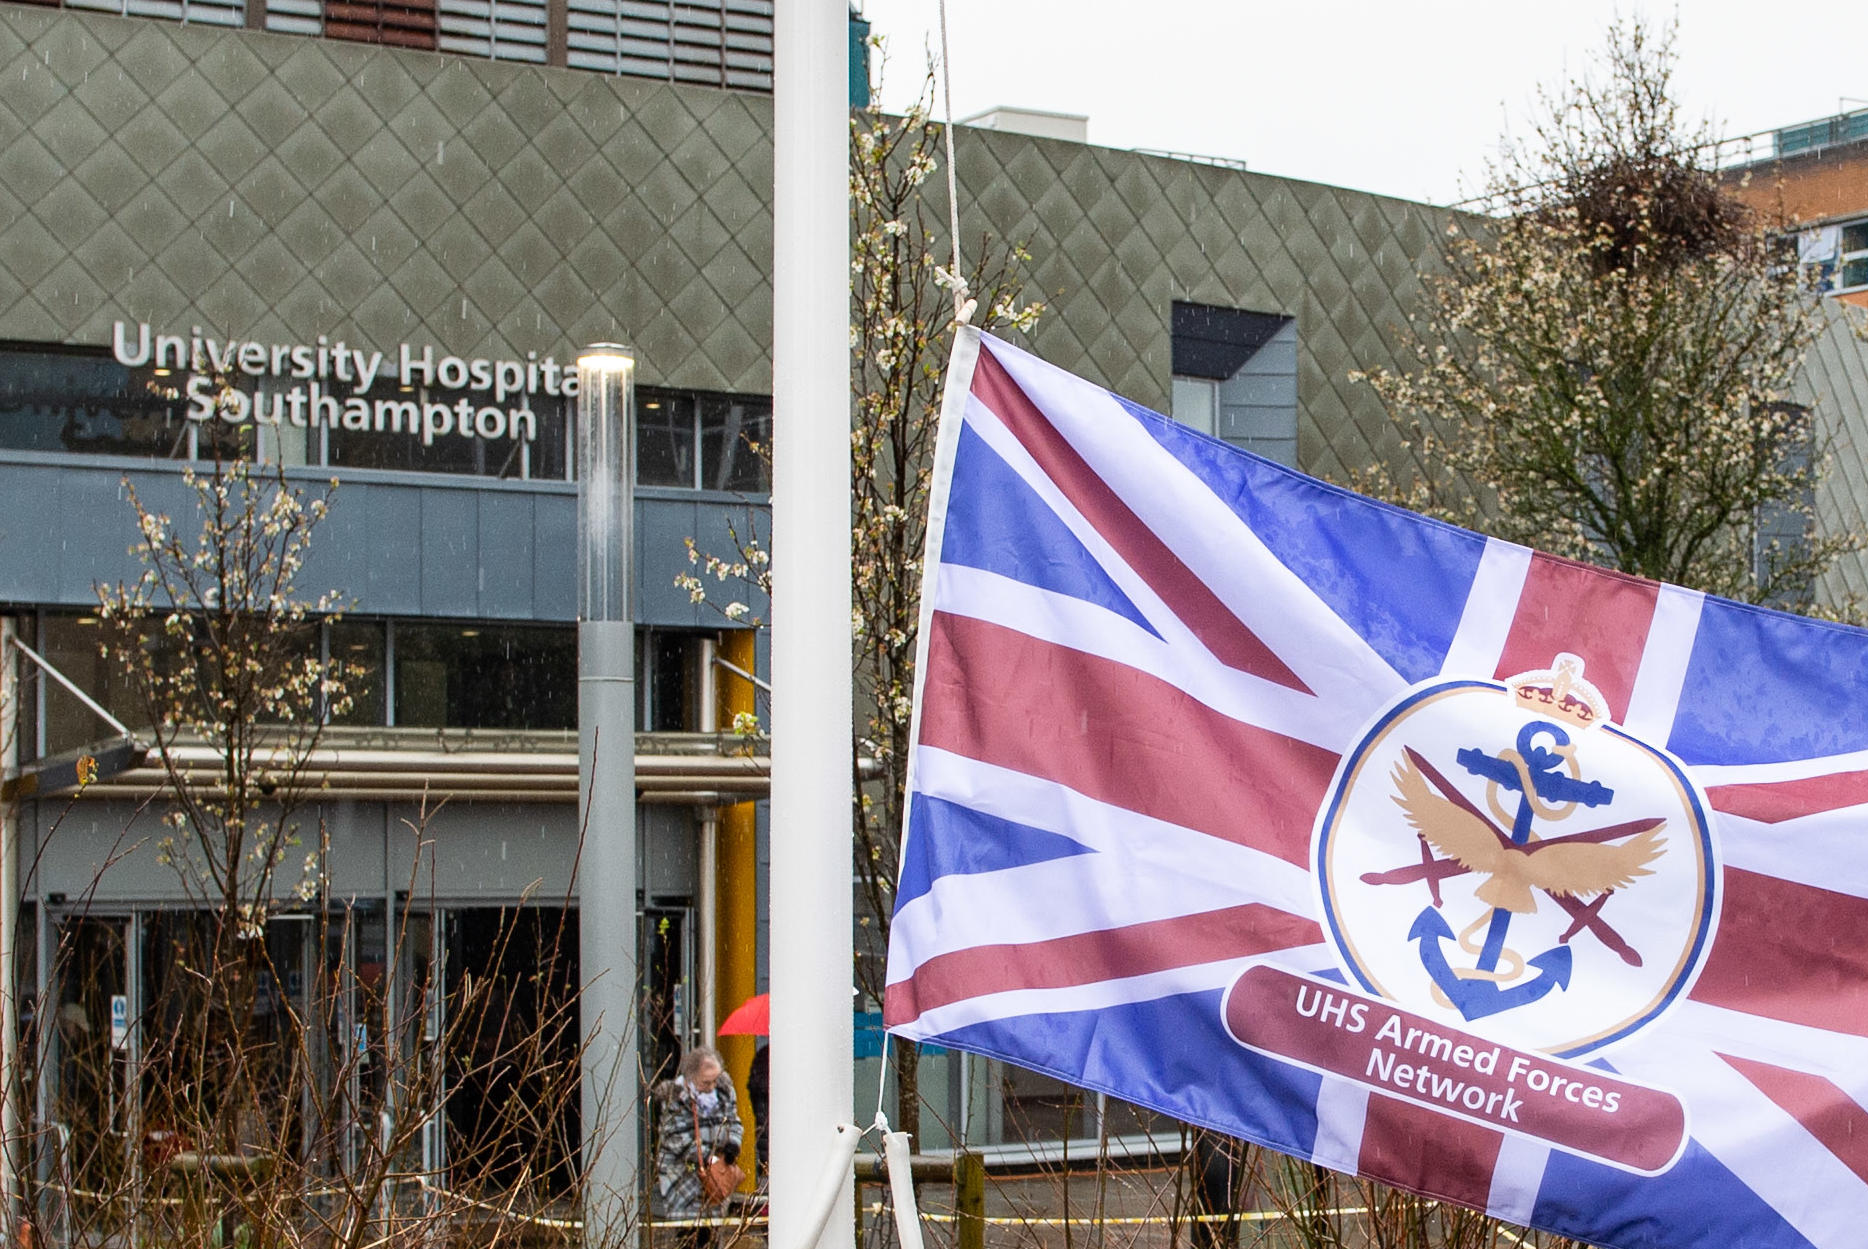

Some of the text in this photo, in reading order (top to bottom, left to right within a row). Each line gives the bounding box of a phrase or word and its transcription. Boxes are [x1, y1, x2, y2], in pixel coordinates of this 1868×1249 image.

[113, 320, 579, 402] University Hospita
[186, 375, 537, 446] Southampton
[1296, 985, 1621, 1113] UHS Armed Forces
[1365, 1048, 1523, 1123] Network
